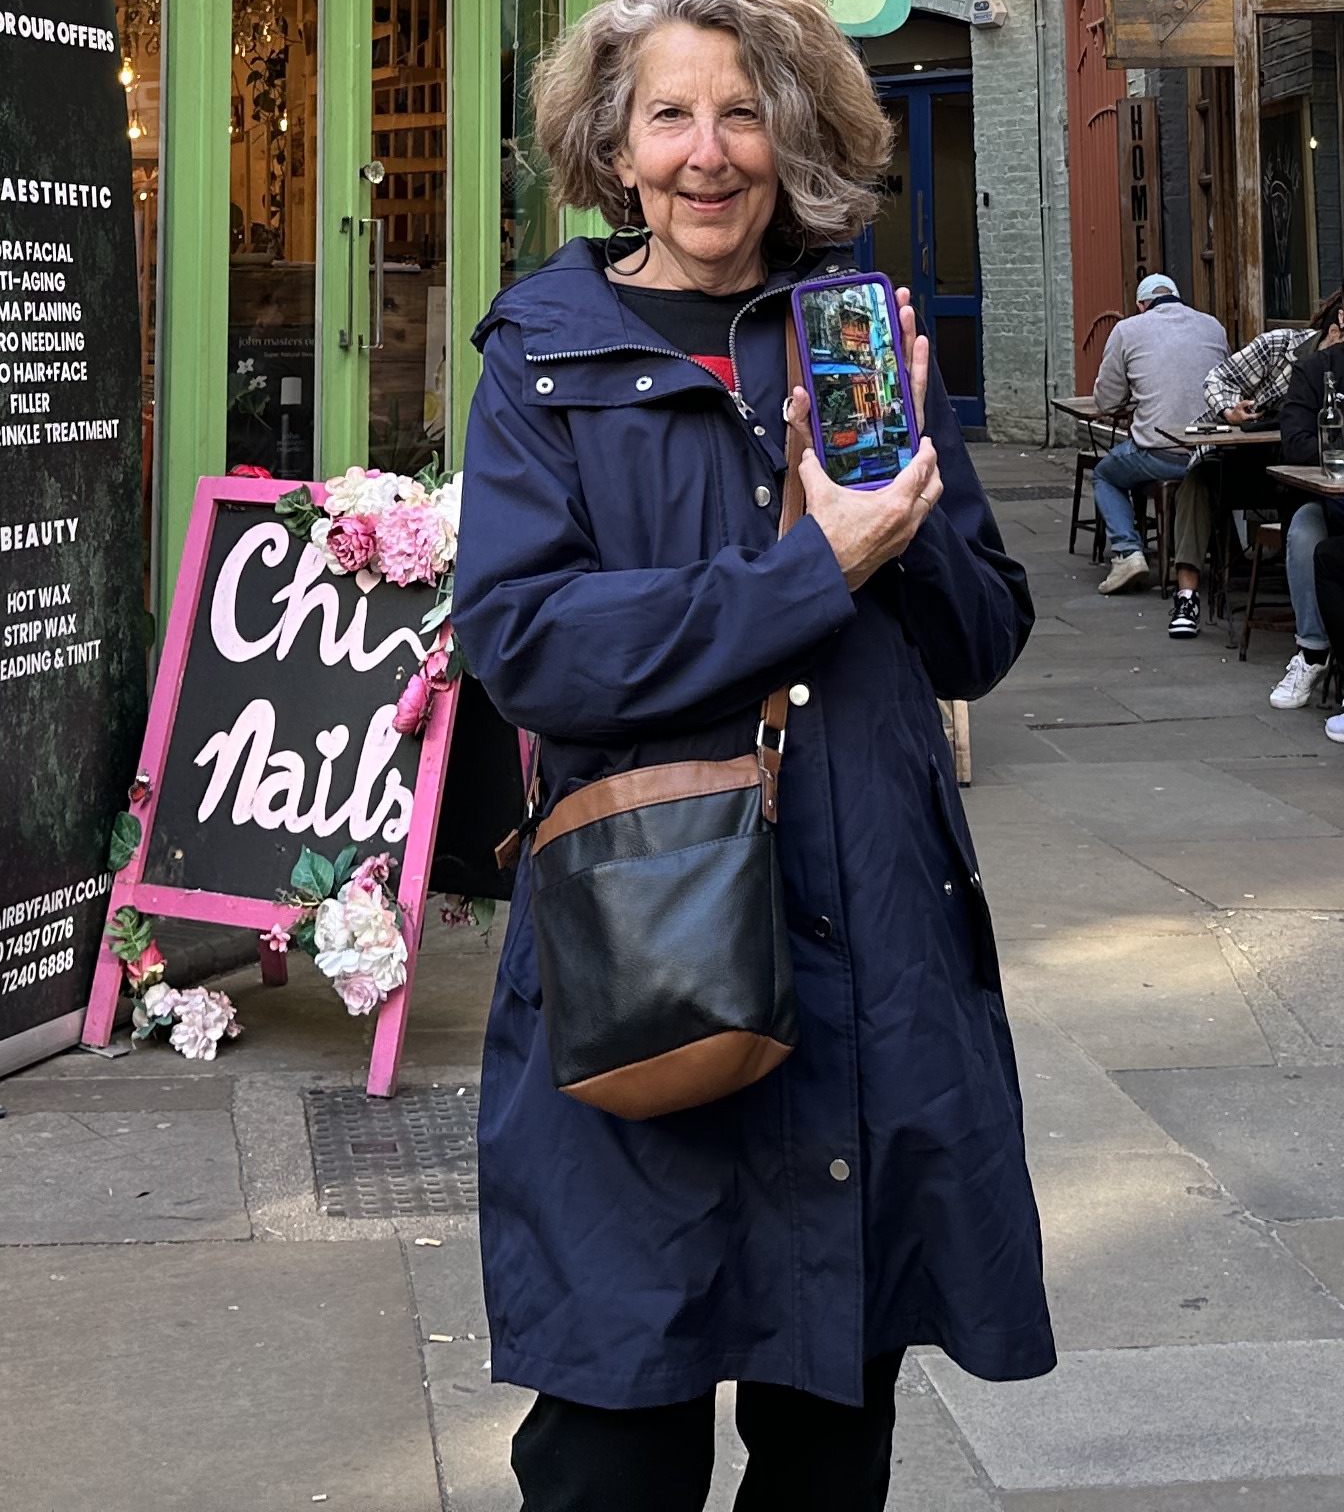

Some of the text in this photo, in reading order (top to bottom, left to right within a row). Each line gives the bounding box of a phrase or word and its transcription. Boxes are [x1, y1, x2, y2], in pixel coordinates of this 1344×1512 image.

[18, 13, 55, 41] OUR
[58, 20, 115, 52] OFFERS
[0, 177, 113, 209] AESTHETIC
[26, 240, 74, 263] FACIAL
[24, 301, 82, 322] PLANING
[21, 332, 85, 352] NEEDLING
[14, 361, 88, 383] HAIR+FACE
[10, 393, 50, 414] FILLER
[45, 419, 119, 444] TREATMENT
[0, 517, 79, 552] BEAUTY
[7, 583, 71, 615] HOT WAX
[4, 612, 77, 647] STRIP WAX
[53, 648, 65, 670] &
[7, 929, 41, 963] 7497
[42, 917, 73, 955] 0776
[2, 962, 35, 997] 7240
[38, 949, 73, 984] 6888
